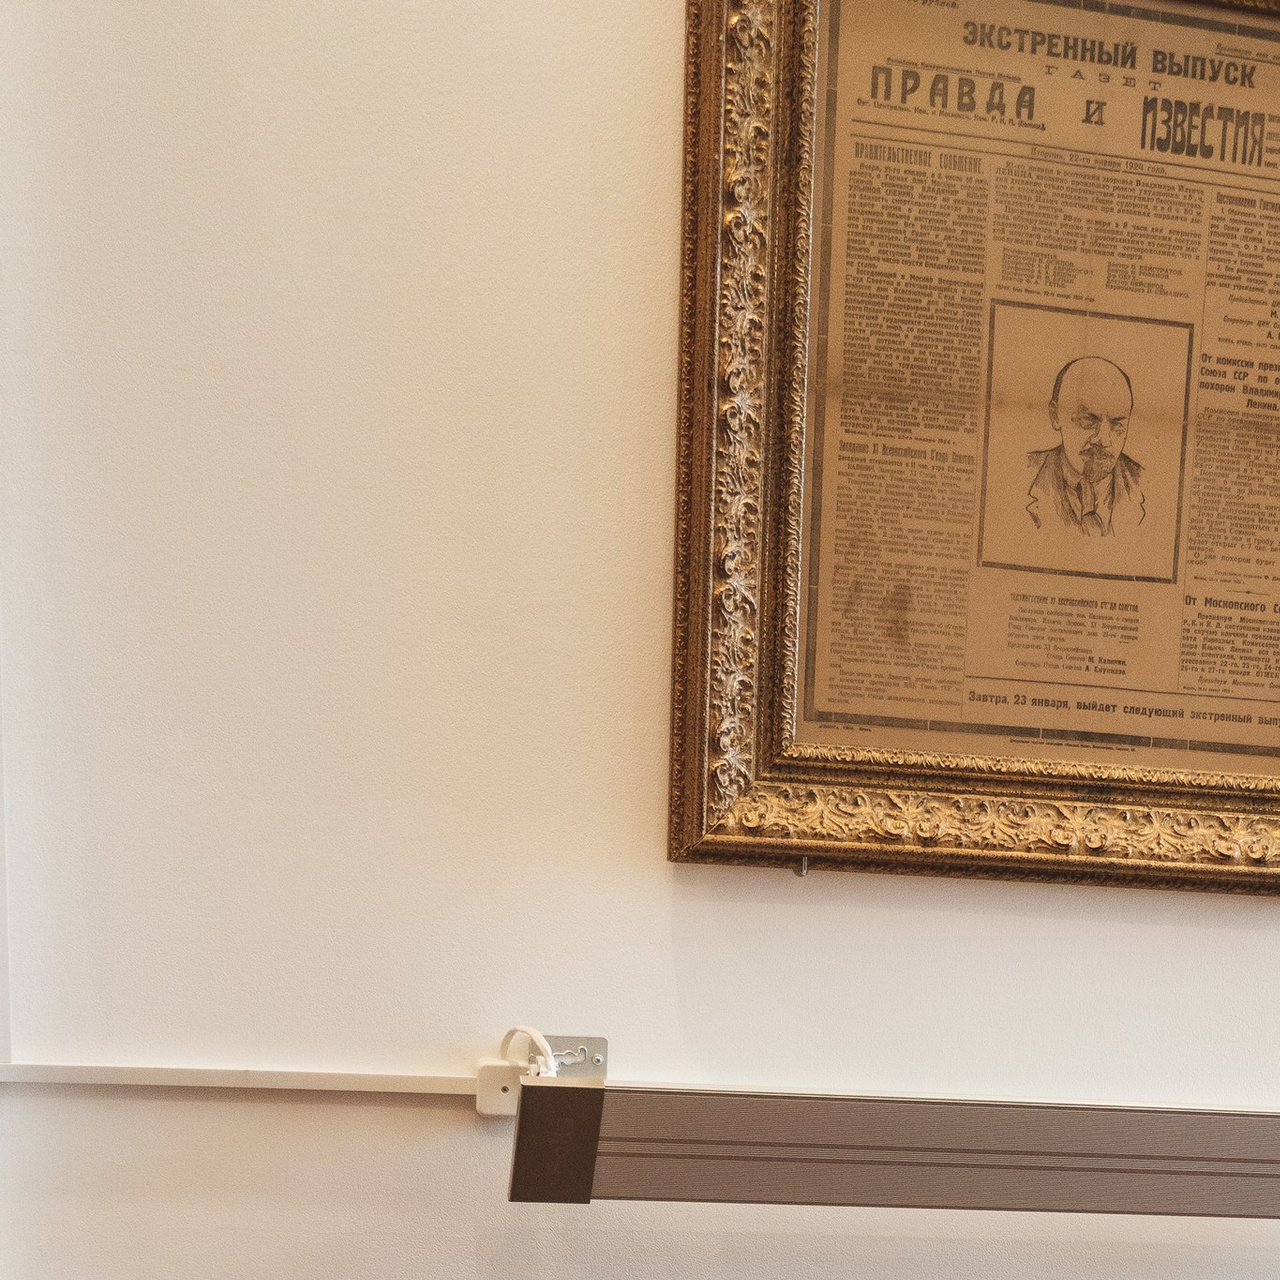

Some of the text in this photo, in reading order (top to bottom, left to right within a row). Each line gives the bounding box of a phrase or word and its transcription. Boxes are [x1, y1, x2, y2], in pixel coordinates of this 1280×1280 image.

[963, 21, 1138, 69] ЭКСТРЕННЫЙ
[1152, 50, 1256, 89] ВЫПУСК
[871, 65, 1035, 121] ПРАВДА
[1082, 100, 1107, 126] И
[1140, 95, 1266, 168] ИЗВЕСТИЯ
[1125, 159, 1145, 173] 1924
[1201, 353, 1212, 363] От
[1216, 356, 1254, 368] комиссии
[1200, 367, 1227, 379] Союза
[1233, 371, 1249, 382] ССР
[1258, 375, 1268, 384] по
[1199, 381, 1235, 393] похорон
[1246, 399, 1279, 411] Ленина.
[1185, 595, 1197, 607] От
[1204, 597, 1266, 612] Московского
[1014, 694, 1026, 706] 23
[1031, 696, 1070, 710] января,
[1076, 700, 1117, 714] выйдет
[1123, 703, 1184, 719] следующий
[1190, 709, 1252, 724] экстренный
